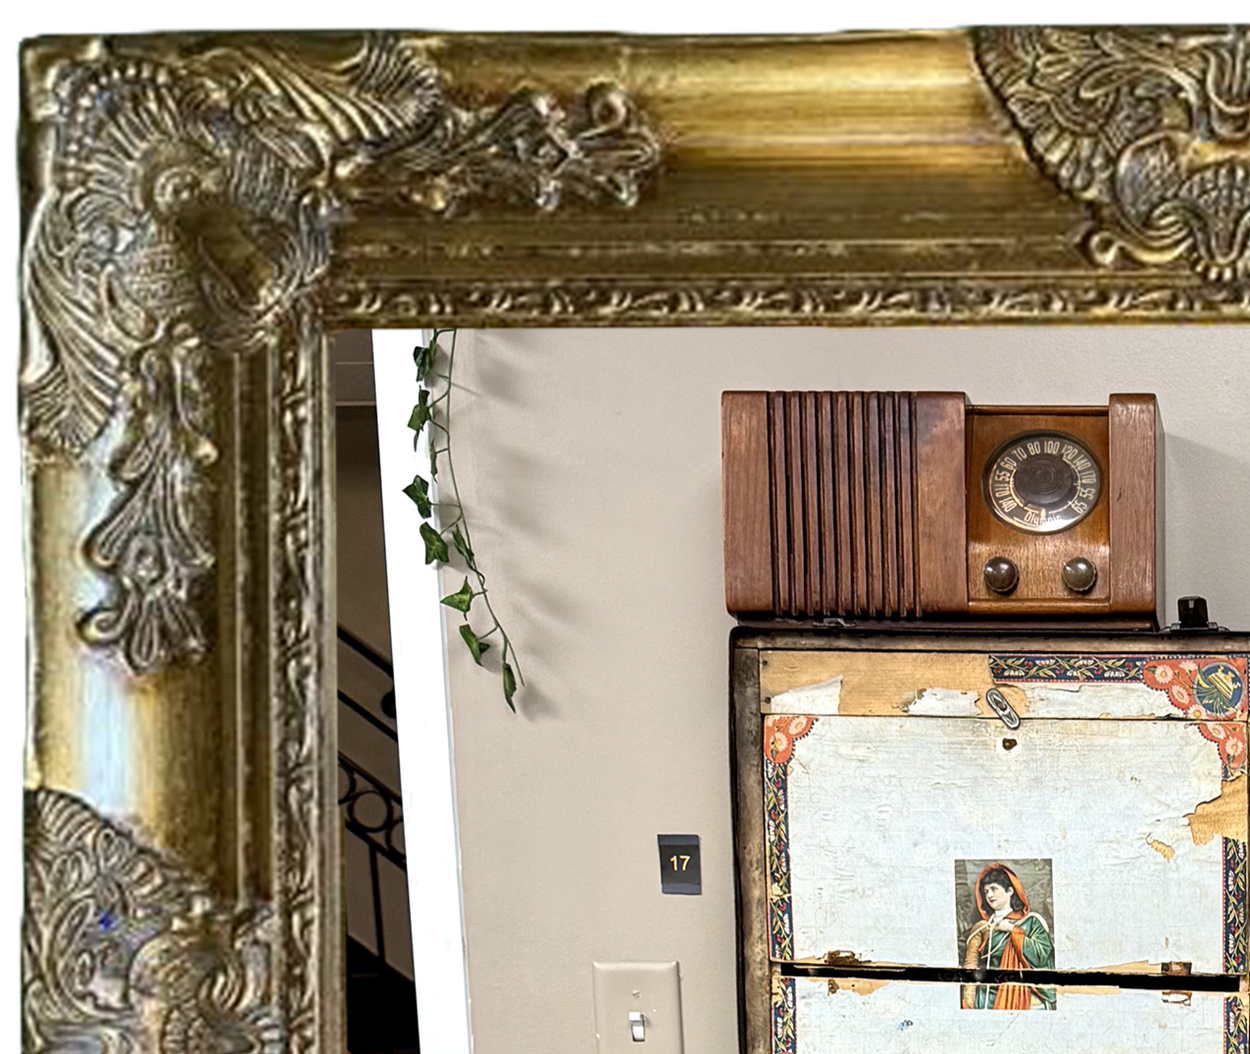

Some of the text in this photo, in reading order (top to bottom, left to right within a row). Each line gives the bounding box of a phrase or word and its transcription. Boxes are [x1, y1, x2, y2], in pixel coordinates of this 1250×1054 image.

[1012, 448, 1027, 461] 70
[1027, 441, 1041, 455] 80
[1044, 441, 1060, 455] 100
[1061, 444, 1078, 460] 120
[1000, 456, 1017, 470] 60
[1073, 454, 1091, 470] 140
[995, 470, 1010, 481] 55
[999, 496, 1017, 512] 140
[1071, 487, 1095, 514] 65 55
[670, 855, 690, 871] 17
